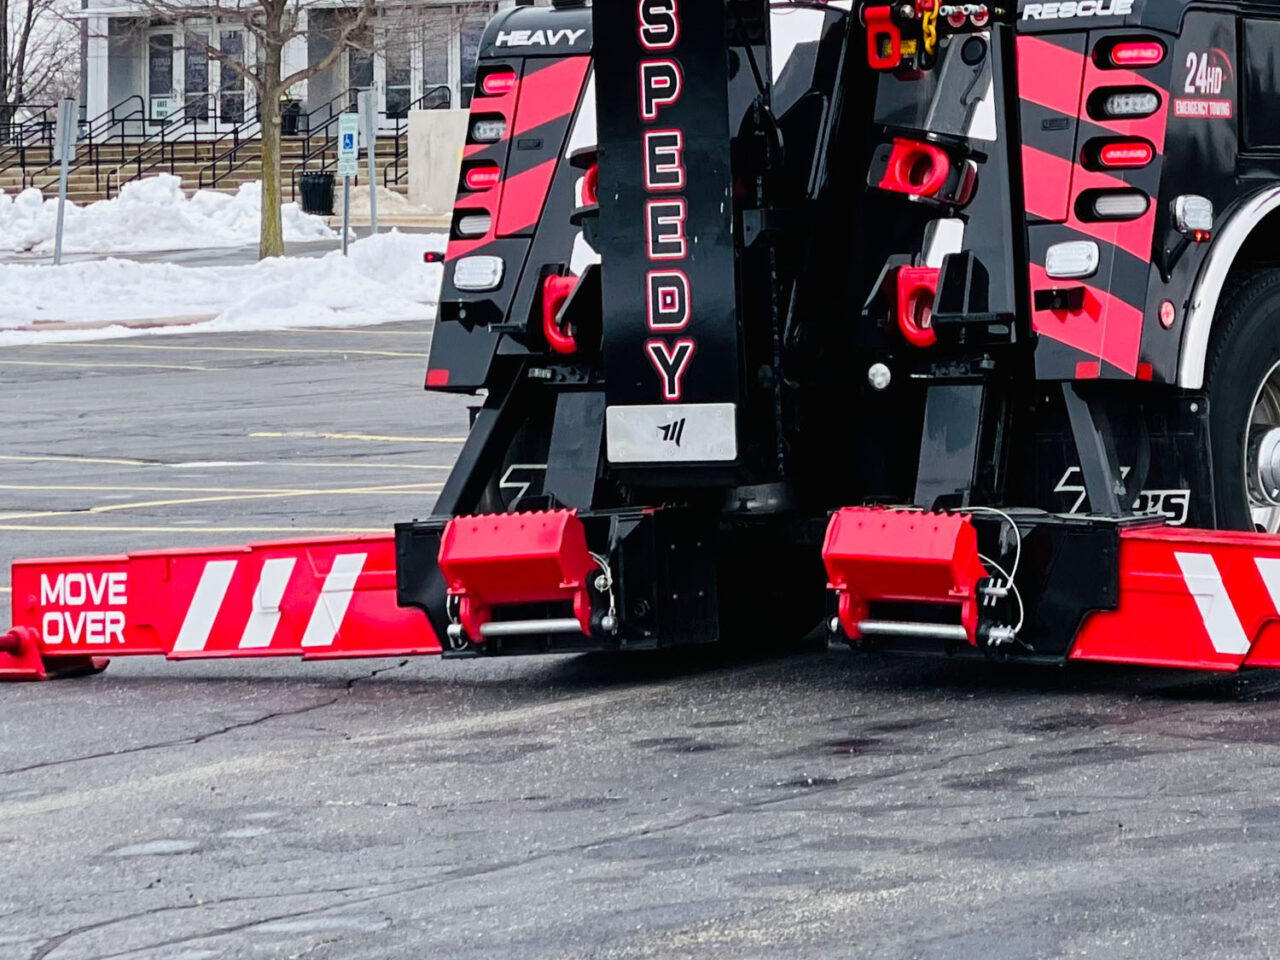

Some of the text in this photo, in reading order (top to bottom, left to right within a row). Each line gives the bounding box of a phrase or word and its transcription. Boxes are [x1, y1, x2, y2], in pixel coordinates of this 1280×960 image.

[495, 29, 586, 47] HEAVY
[41, 572, 128, 607] MOVE
[42, 611, 126, 645] OVER
